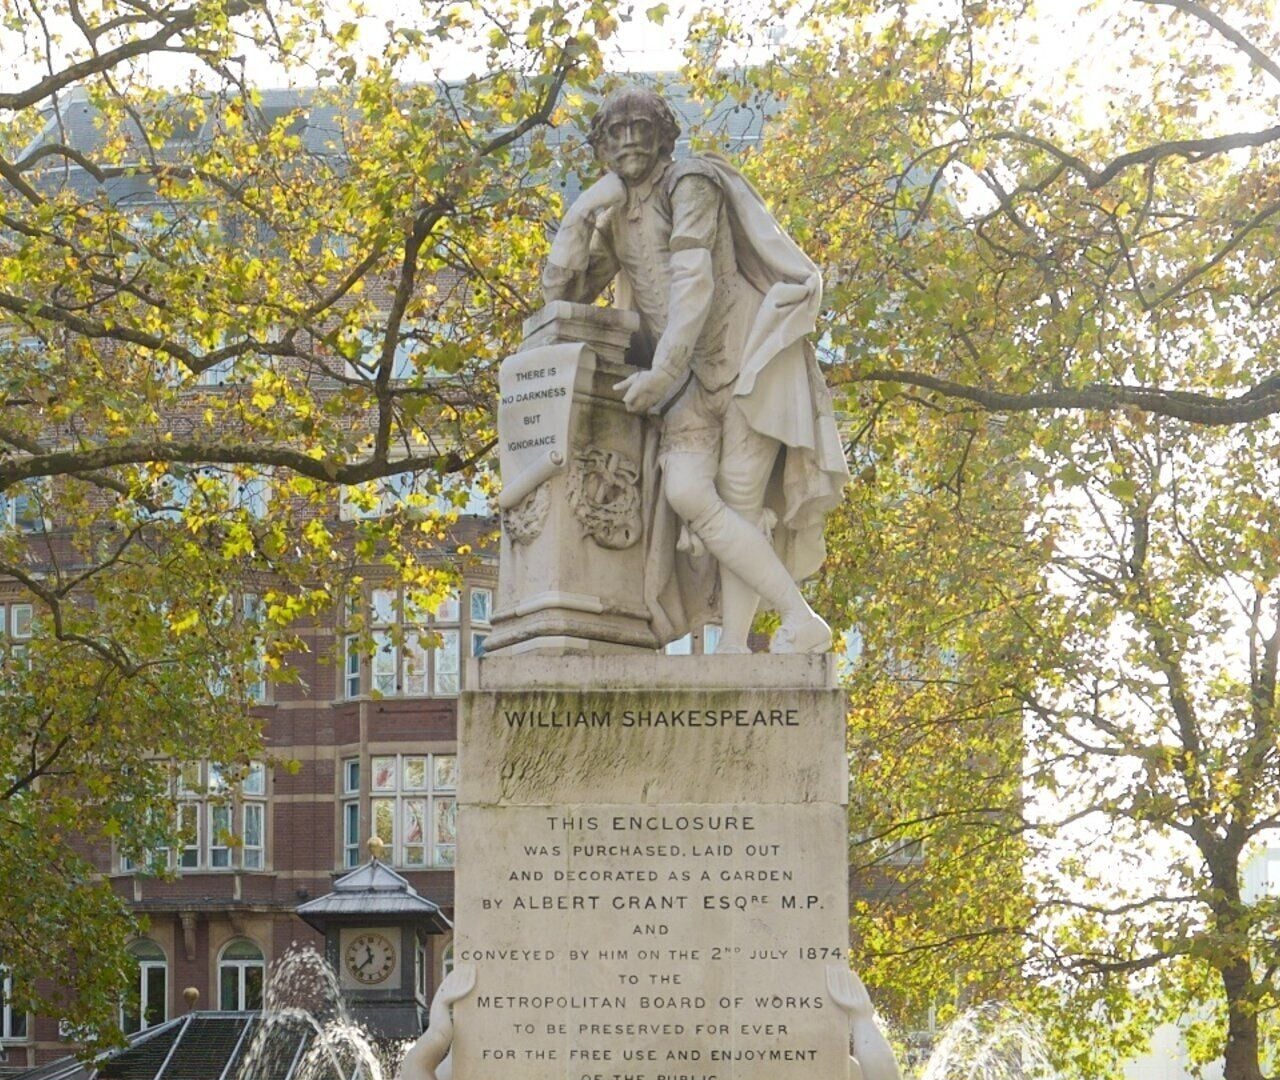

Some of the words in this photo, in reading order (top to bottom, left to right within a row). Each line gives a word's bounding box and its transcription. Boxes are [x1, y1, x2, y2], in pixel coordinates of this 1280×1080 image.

[516, 368, 545, 381] THERE
[548, 367, 557, 376] IS
[502, 395, 514, 405] NO
[516, 387, 566, 402] DARKNESS
[524, 414, 541, 425] BUT
[508, 435, 556, 452] IGNORANCE
[505, 710, 611, 727] WILLIAM
[622, 710, 800, 727] SHAKESPEARE
[547, 817, 599, 830] THIS
[613, 816, 755, 830] ENCLOSURE
[524, 845, 561, 857] WAS
[693, 845, 733, 857] LAID
[746, 845, 779, 857] OUT
[509, 870, 543, 881] AND
[554, 870, 658, 881] DECORATED
[668, 870, 690, 881] AS
[700, 870, 711, 881] A
[720, 870, 793, 881] GARDEN
[482, 898, 502, 909] BY
[512, 896, 598, 909] ALBERT
[612, 896, 688, 909] GRANT
[781, 896, 824, 909] M.P.
[633, 924, 668, 935] AND
[461, 950, 554, 961] CONVEYED
[570, 949, 589, 961] BY
[599, 949, 629, 961] HIM
[638, 949, 659, 961] ON
[669, 949, 700, 961] THE
[750, 948, 788, 960] JULY
[618, 974, 639, 985] TO
[650, 974, 681, 985] THE
[477, 997, 625, 1009] METROPOLITAN
[640, 997, 706, 1009] BOARD
[719, 997, 743, 1009] OF
[755, 996, 823, 1009] WORKS
[514, 1024, 535, 1034] TO
[547, 1024, 567, 1034] BE
[579, 1024, 684, 1034] PRESERVED
[696, 1024, 729, 1034] FOR
[740, 1024, 788, 1034] EVER
[482, 1049, 515, 1060] FOR
[526, 1049, 557, 1060] THE
[570, 1049, 612, 1060] FREE
[623, 1049, 657, 1060] USE
[666, 1049, 700, 1060] AND
[711, 1049, 818, 1061] ENJOYMENT
